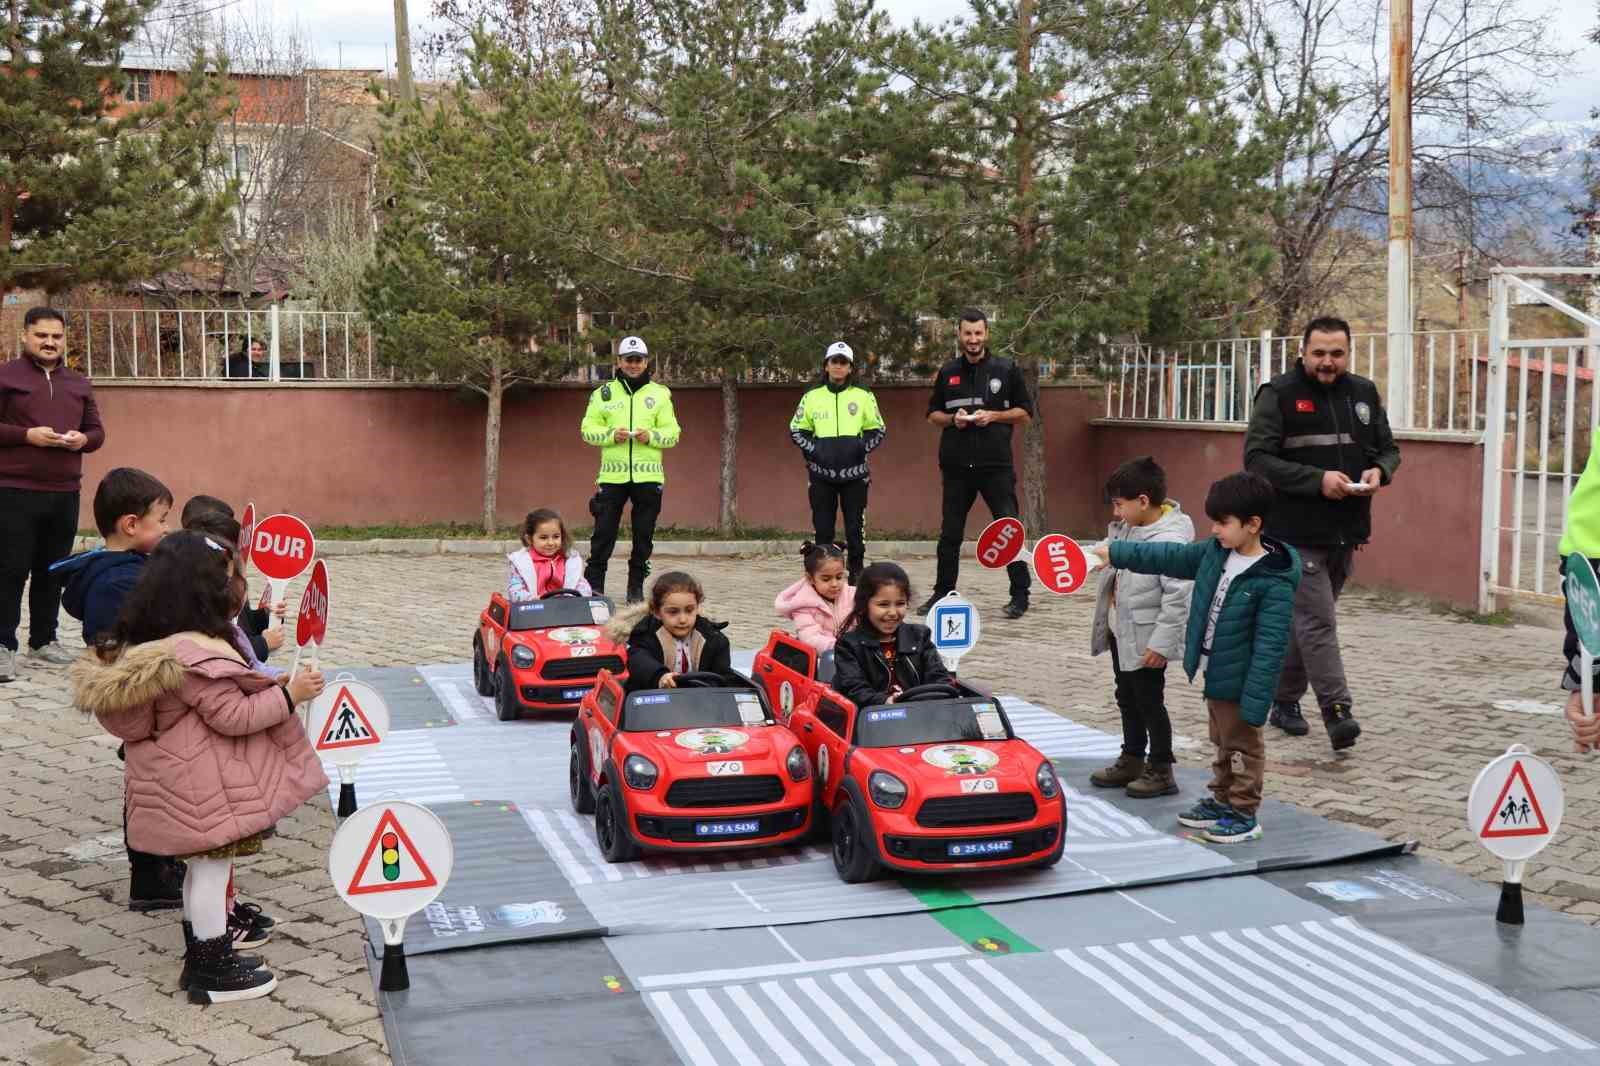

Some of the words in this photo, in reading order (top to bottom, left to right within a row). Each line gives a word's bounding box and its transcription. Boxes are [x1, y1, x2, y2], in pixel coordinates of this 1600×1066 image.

[255, 531, 306, 560] DUR
[982, 522, 1018, 563] DUR
[1047, 541, 1074, 588] DUR
[712, 823, 723, 833] 25
[725, 823, 733, 832] A
[977, 844, 986, 852] A
